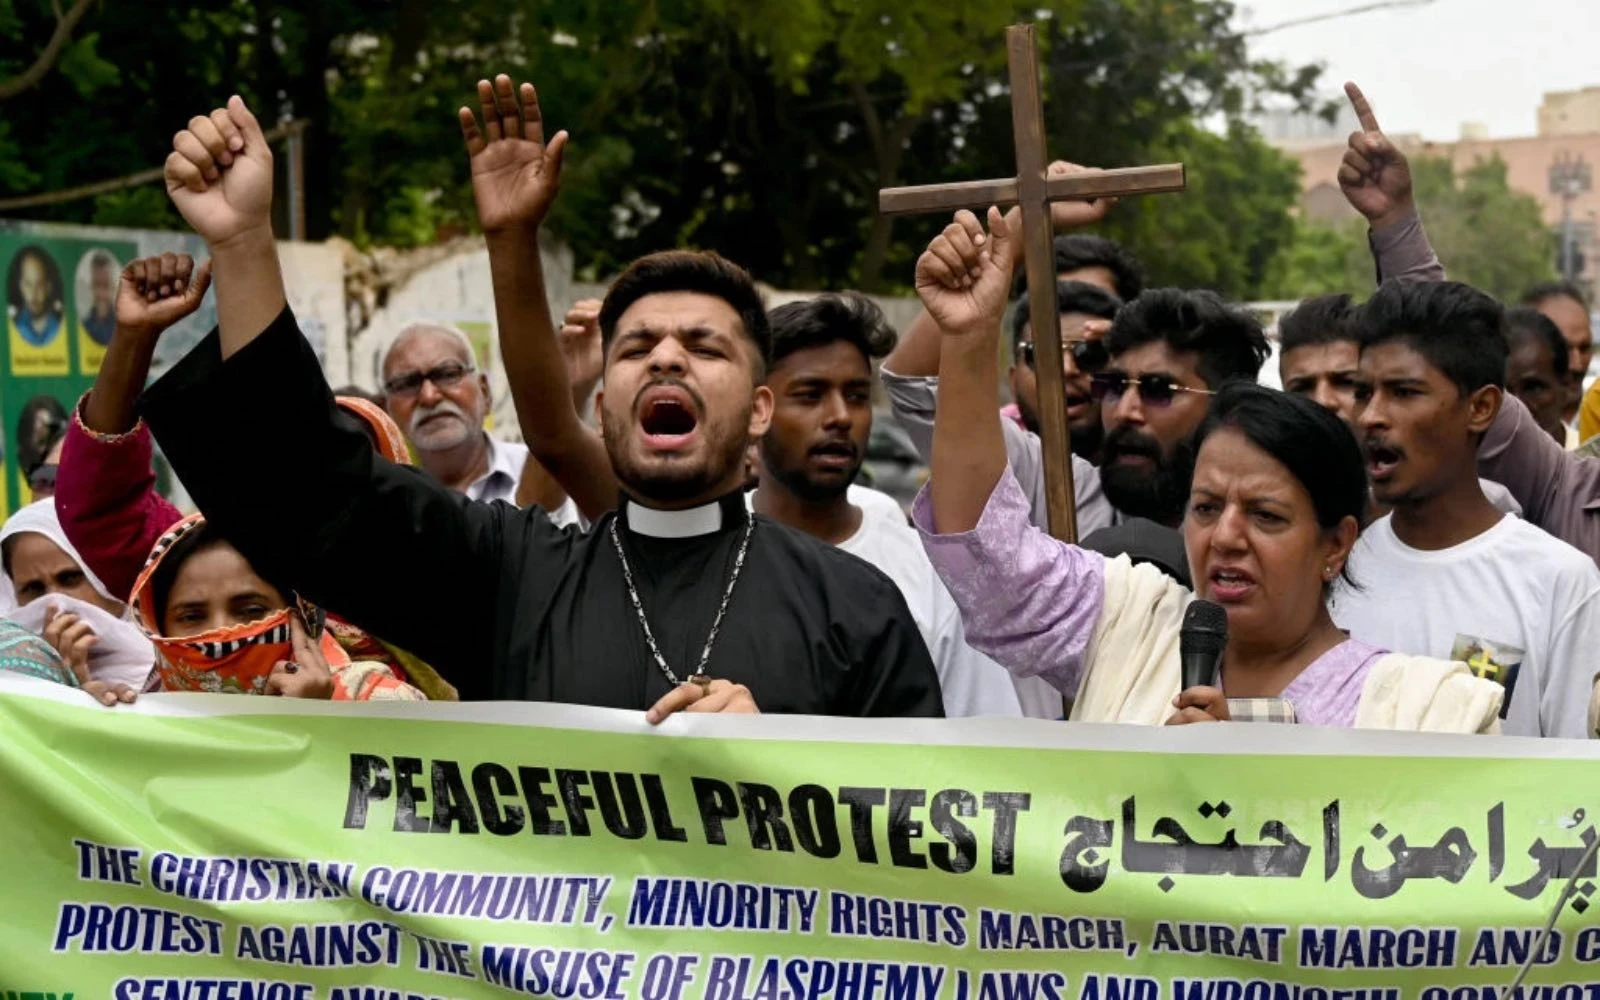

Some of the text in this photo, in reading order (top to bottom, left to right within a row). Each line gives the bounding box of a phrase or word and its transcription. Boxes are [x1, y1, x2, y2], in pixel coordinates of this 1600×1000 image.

[343, 753, 1032, 876] PEACEFUL PROTEST
[1059, 795, 1340, 893] احتجاج
[54, 904, 223, 954] PROTEST
[237, 922, 402, 967] AGAINST
[411, 933, 476, 978] THE
[482, 945, 635, 998] MISUSE
[642, 954, 698, 1000] OF
[705, 957, 945, 1000] BLASPHEMY
[75, 840, 142, 886] THE
[151, 852, 354, 902] CHRISTIAN
[361, 866, 614, 932] COMMUNITY,
[627, 878, 818, 932] MINORITY
[830, 891, 967, 946] RIGHTS
[980, 910, 1138, 957] MARCH,
[1152, 923, 1287, 962] AURAT
[1300, 928, 1457, 968] MARCH
[1469, 929, 1562, 966] AND
